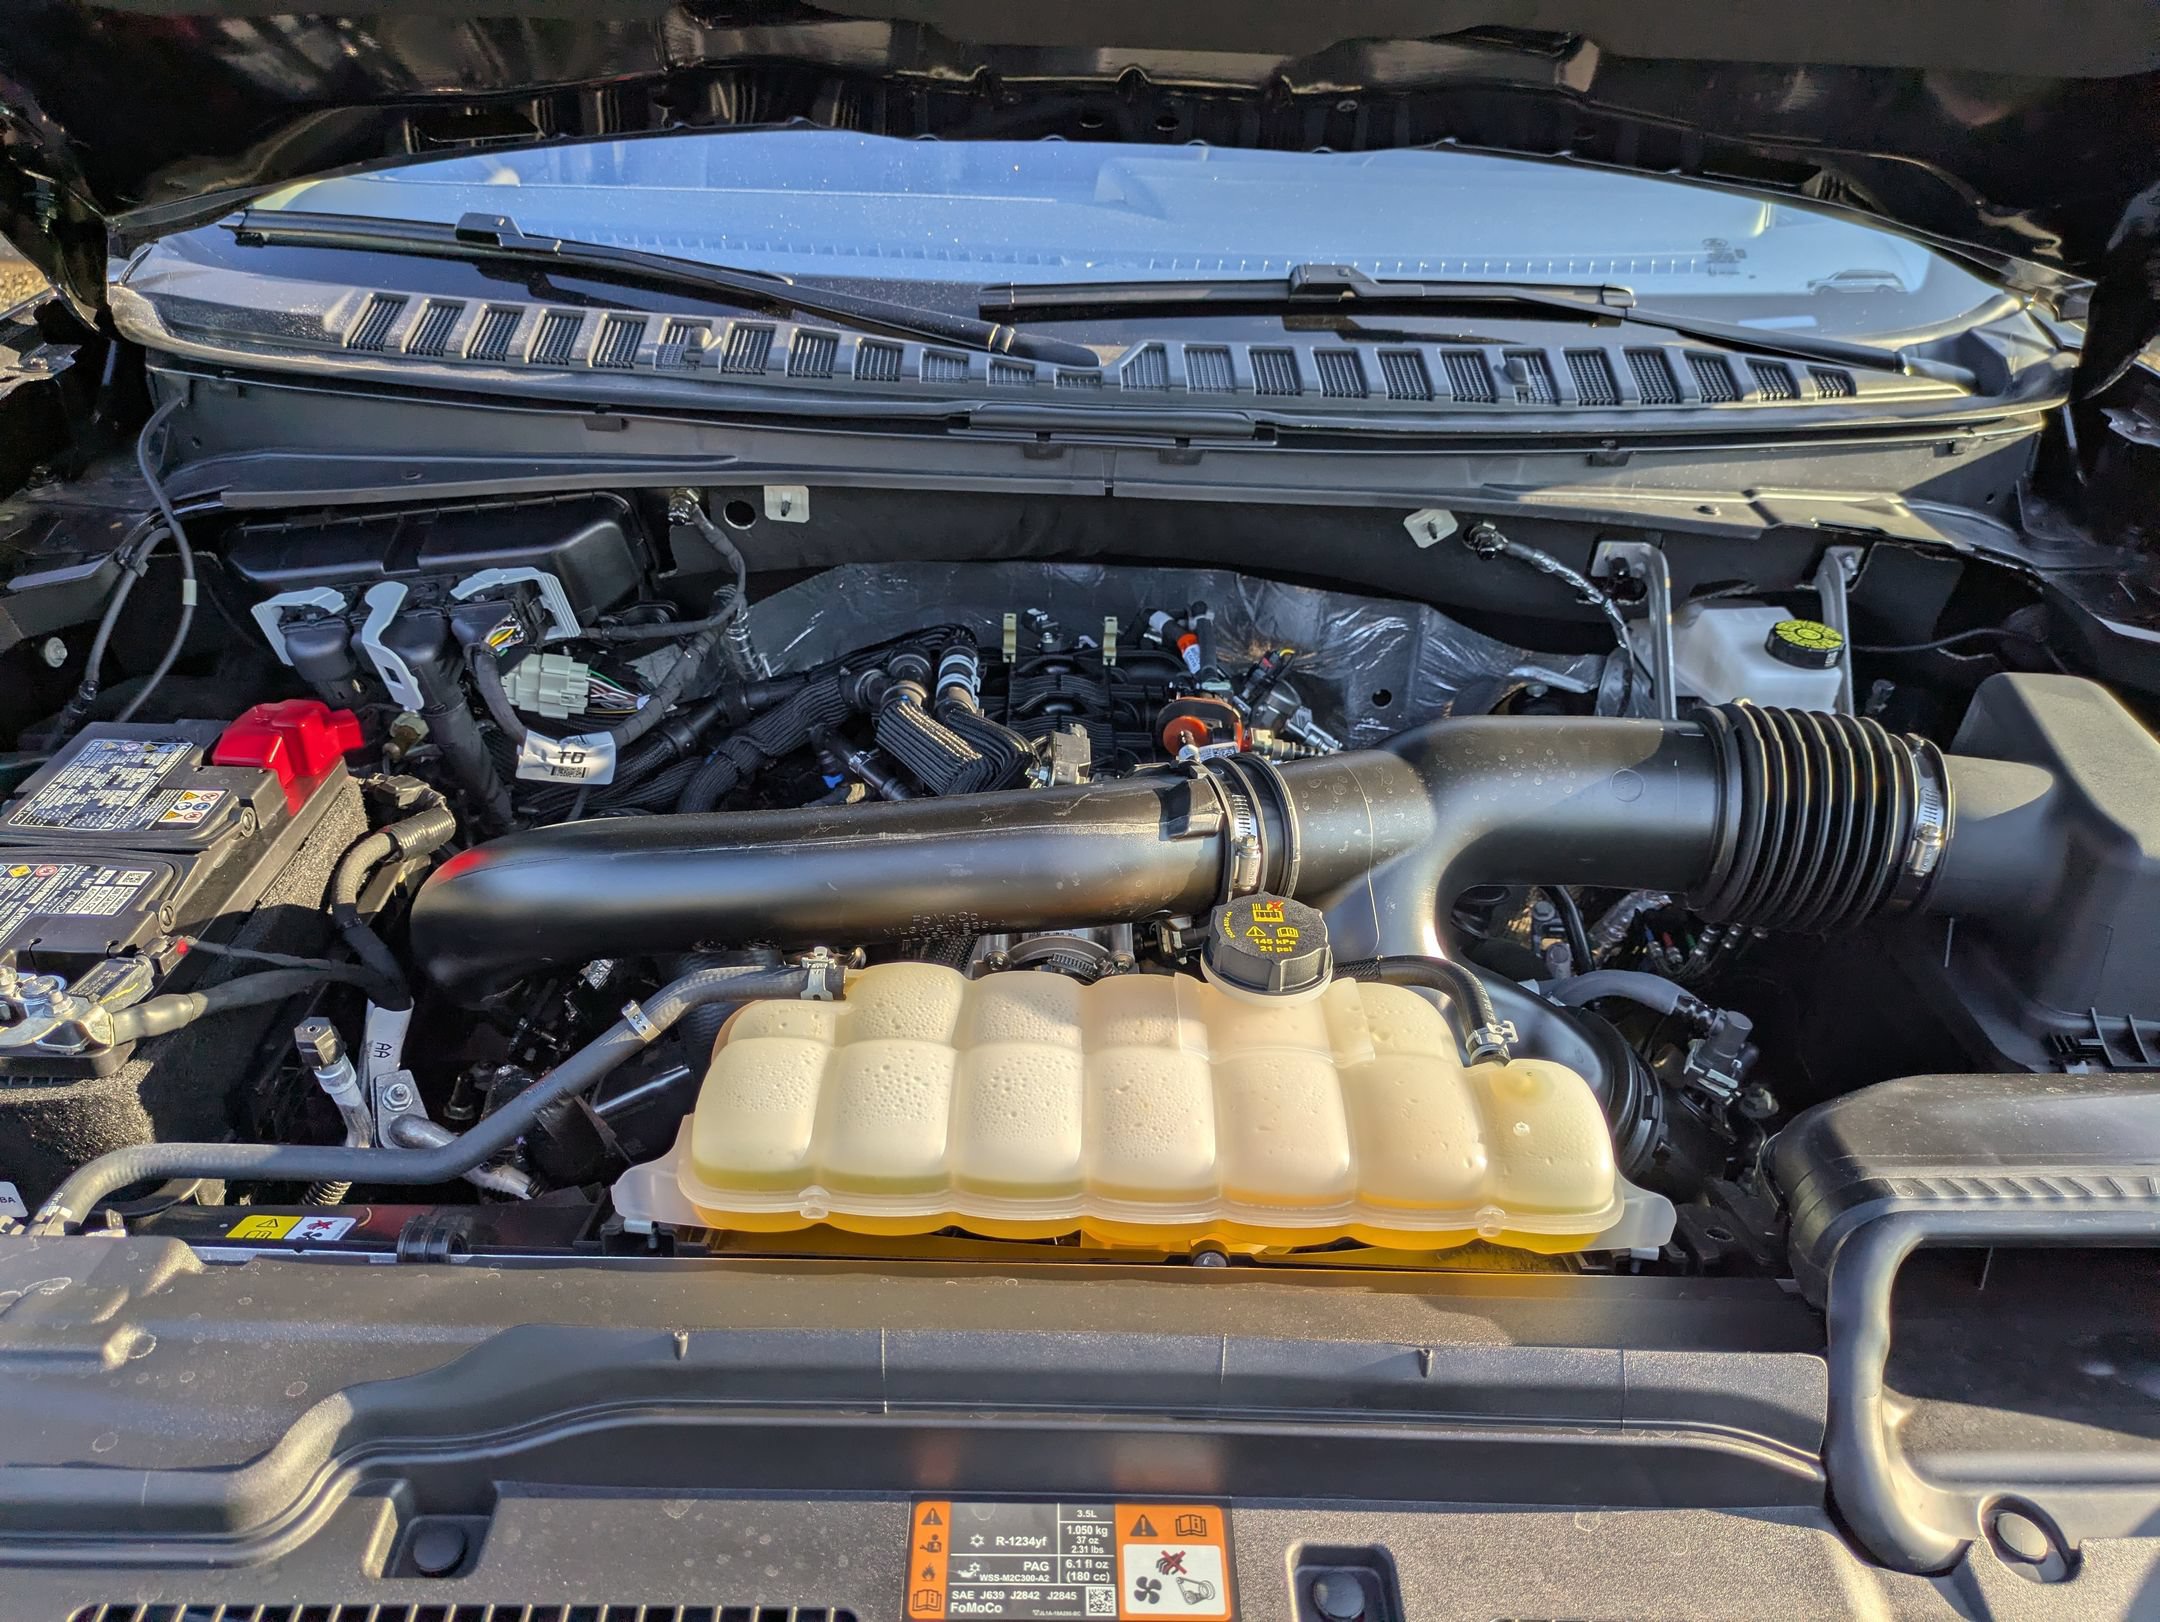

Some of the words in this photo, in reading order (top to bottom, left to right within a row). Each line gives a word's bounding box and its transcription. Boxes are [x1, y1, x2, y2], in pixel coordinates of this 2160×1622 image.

[1077, 1510, 1097, 1518] 3.5L
[1067, 1525, 1093, 1535] 1.050
[1096, 1526, 1108, 1537] kg
[996, 1536, 1047, 1548] R-1234yf
[1024, 1562, 1049, 1571] PAG
[1066, 1559, 1082, 1568] 6.1
[1085, 1559, 1093, 1568] fl
[1067, 1572, 1090, 1582] (180
[1093, 1572, 1110, 1583] cc)
[952, 1591, 974, 1600] SAE
[980, 1591, 1005, 1600] J639
[1010, 1591, 1040, 1600] J2842
[1047, 1592, 1077, 1600] J2845
[950, 1602, 1003, 1613] FoMoCo
